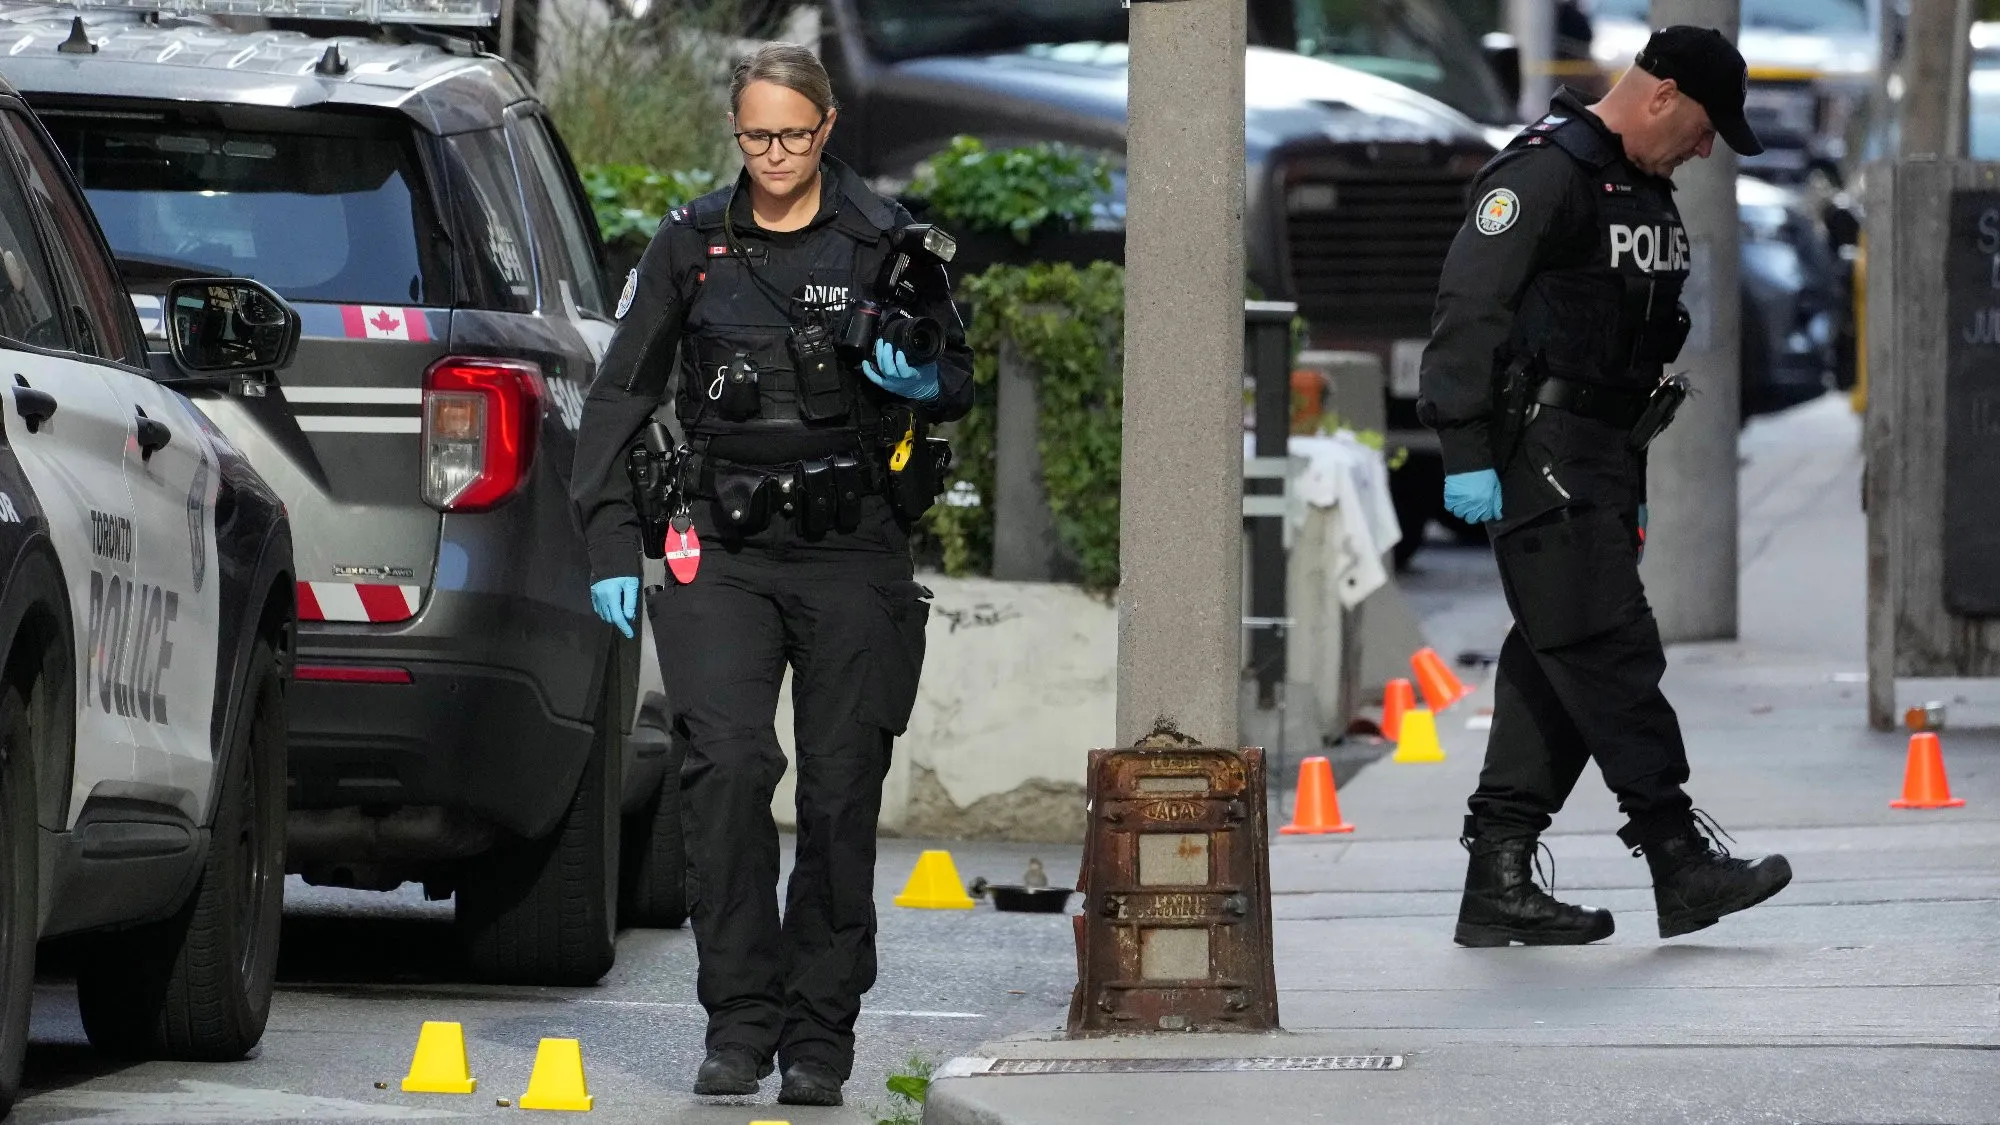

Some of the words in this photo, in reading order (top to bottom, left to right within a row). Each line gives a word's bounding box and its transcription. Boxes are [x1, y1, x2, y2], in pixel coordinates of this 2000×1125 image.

[1609, 223, 1691, 273] POLICE
[804, 284, 848, 310] POLICE
[90, 509, 132, 563] TORONTO
[86, 570, 179, 726] POLICE
